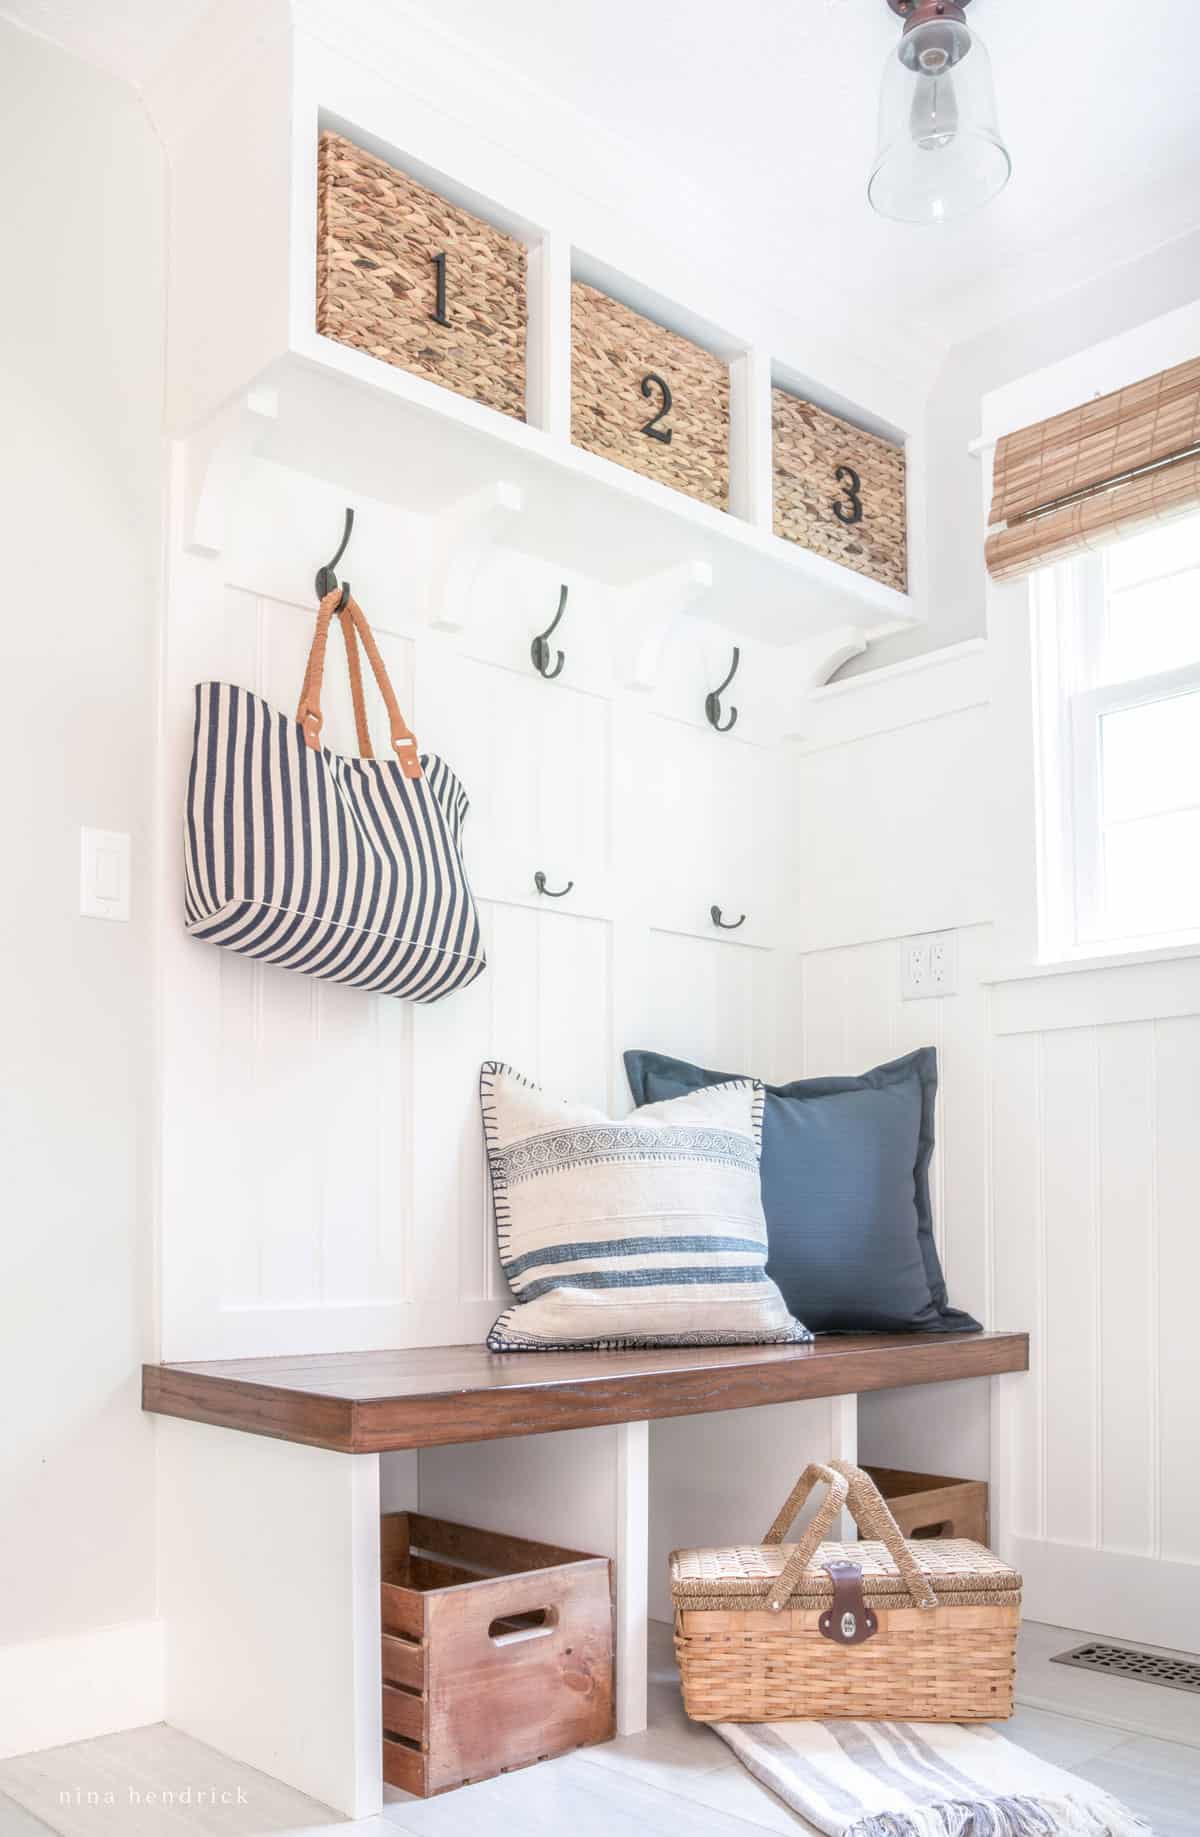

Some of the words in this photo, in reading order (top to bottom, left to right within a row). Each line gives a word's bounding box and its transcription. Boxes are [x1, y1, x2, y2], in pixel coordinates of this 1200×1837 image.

[428, 252, 452, 328] 1
[640, 374, 672, 443] 2
[833, 465, 862, 524] 3
